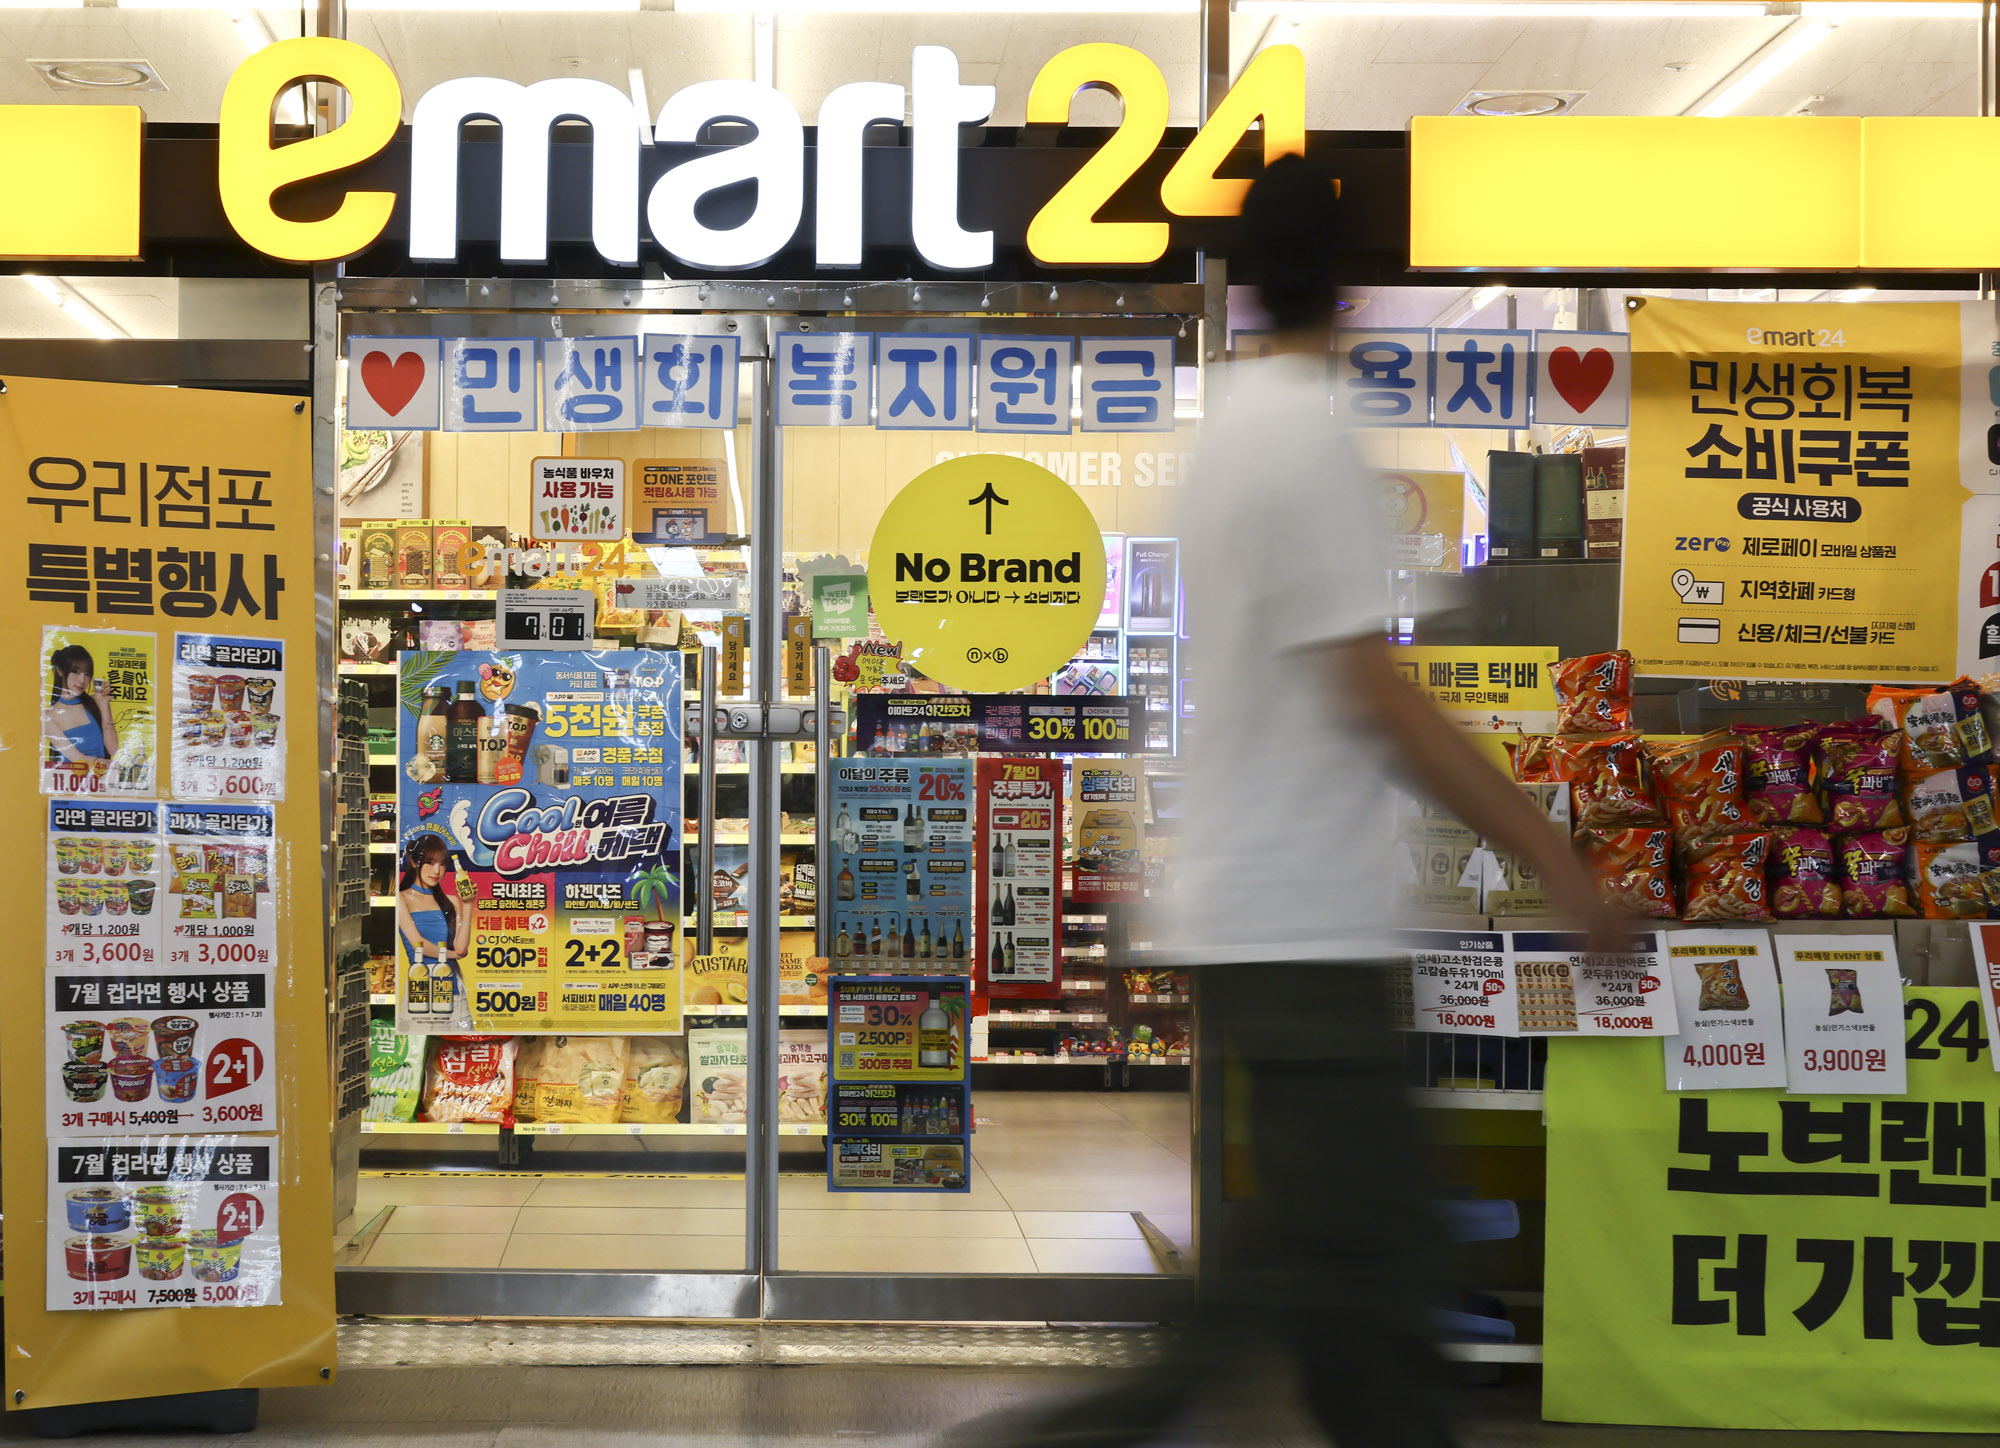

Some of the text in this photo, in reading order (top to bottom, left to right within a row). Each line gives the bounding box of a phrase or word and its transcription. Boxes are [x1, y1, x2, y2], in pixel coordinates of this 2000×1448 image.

[1747, 328, 1846, 348] emart24
[1689, 360, 1913, 422] 민생회복
[1685, 423, 1911, 487] 소비쿠폰
[543, 467, 614, 480] 농식품 바우처
[644, 473, 718, 486] CJ ONE 포인트
[26, 456, 276, 531] 우리점포
[542, 481, 614, 499] 사용 가능
[698, 487, 718, 499] 가능
[1752, 497, 1848, 519] 공식 사용처
[1742, 537, 1818, 558] 제로페이
[1820, 543, 1858, 559] 모바일
[1860, 543, 1897, 560] 상품권
[457, 541, 629, 578] emart24
[895, 550, 1081, 584] No Brand
[26, 542, 286, 621] 특별행사
[1740, 580, 1856, 601] 지역화폐 카드형
[824, 597, 852, 606] TOON
[826, 590, 848, 599] WEB
[1737, 622, 1896, 645] 신용/체크/선불 카드
[216, 645, 276, 665] 골라담기
[863, 640, 903, 658] New!
[729, 640, 739, 682] 당기세요
[794, 640, 804, 682] 당기세요
[107, 670, 148, 686] 흔들어
[1429, 662, 1538, 689] 빠른 택배
[109, 685, 148, 701] 주세요
[1439, 691, 1510, 704] 국제 무인택배
[544, 703, 635, 738] 5천원
[887, 705, 926, 717] 이마트24
[1028, 718, 1076, 741] 30%
[602, 747, 664, 764] 경품 추첨
[573, 775, 664, 787] 매주 10명 10명
[839, 767, 911, 783] 이달의 주류
[1002, 765, 1040, 781] 7월의
[207, 775, 277, 796] 3,600원
[918, 773, 966, 801] 20%
[992, 781, 1052, 798] 주류특가
[55, 810, 152, 828] 라면 골라담기
[169, 813, 268, 832] 과자 골라담기
[479, 789, 578, 842] Cool
[583, 796, 649, 829] 여름
[496, 829, 591, 872] Chill
[1645, 829, 1668, 899] 새우깡
[492, 883, 546, 899] 국내최초
[69, 923, 92, 936] 개당
[184, 924, 208, 937] 개당
[476, 916, 530, 931] 더블 혜택
[500, 935, 521, 944] ONE
[1460, 941, 1494, 950] 인기상품
[55, 943, 154, 964] 3개 3,600원
[171, 943, 269, 965] 3개 3,000원
[476, 947, 537, 968] 500P
[564, 938, 622, 968] 2+2
[1671, 946, 1757, 957] 우리매장 EVENT 상품
[1796, 952, 1883, 962] 우리매장 EVENT 상품
[691, 956, 748, 976] CUSTAR
[1418, 966, 1504, 979] 고칼슘두유190ml
[69, 981, 250, 1005] 7월 컵라면 행사 상품
[1454, 981, 1479, 992] 24개
[476, 991, 537, 1012] 500원
[562, 993, 666, 1012] 서피비치 매일 40명
[1439, 995, 1490, 1007] 36,000원
[1595, 995, 1647, 1007] 36,000원
[868, 1005, 913, 1027] 30%
[1436, 1013, 1496, 1029] 18,000원
[1593, 1016, 1654, 1031] 18,000원
[716, 1043, 740, 1053] 유기농
[789, 1043, 812, 1053] 유기농
[1683, 1042, 1766, 1068] 4,000원
[213, 1046, 256, 1085] 2+1
[699, 1054, 729, 1066] 쌀과자
[858, 1058, 892, 1070] 300명
[1803, 1048, 1887, 1073] 3,900원
[543, 1094, 573, 1110] 쌀과자
[62, 1103, 263, 1128] 3개 구매시 5,400원 3,600원
[1667, 1097, 2000, 1208] 노브랜
[72, 1154, 105, 1176] 7월
[111, 1153, 168, 1176] 컵라면
[216, 1153, 254, 1175] 상품
[222, 1200, 257, 1232] 2+1
[1672, 1233, 1768, 1336] 더
[73, 1287, 196, 1305] 3개 구매시 7,500원
